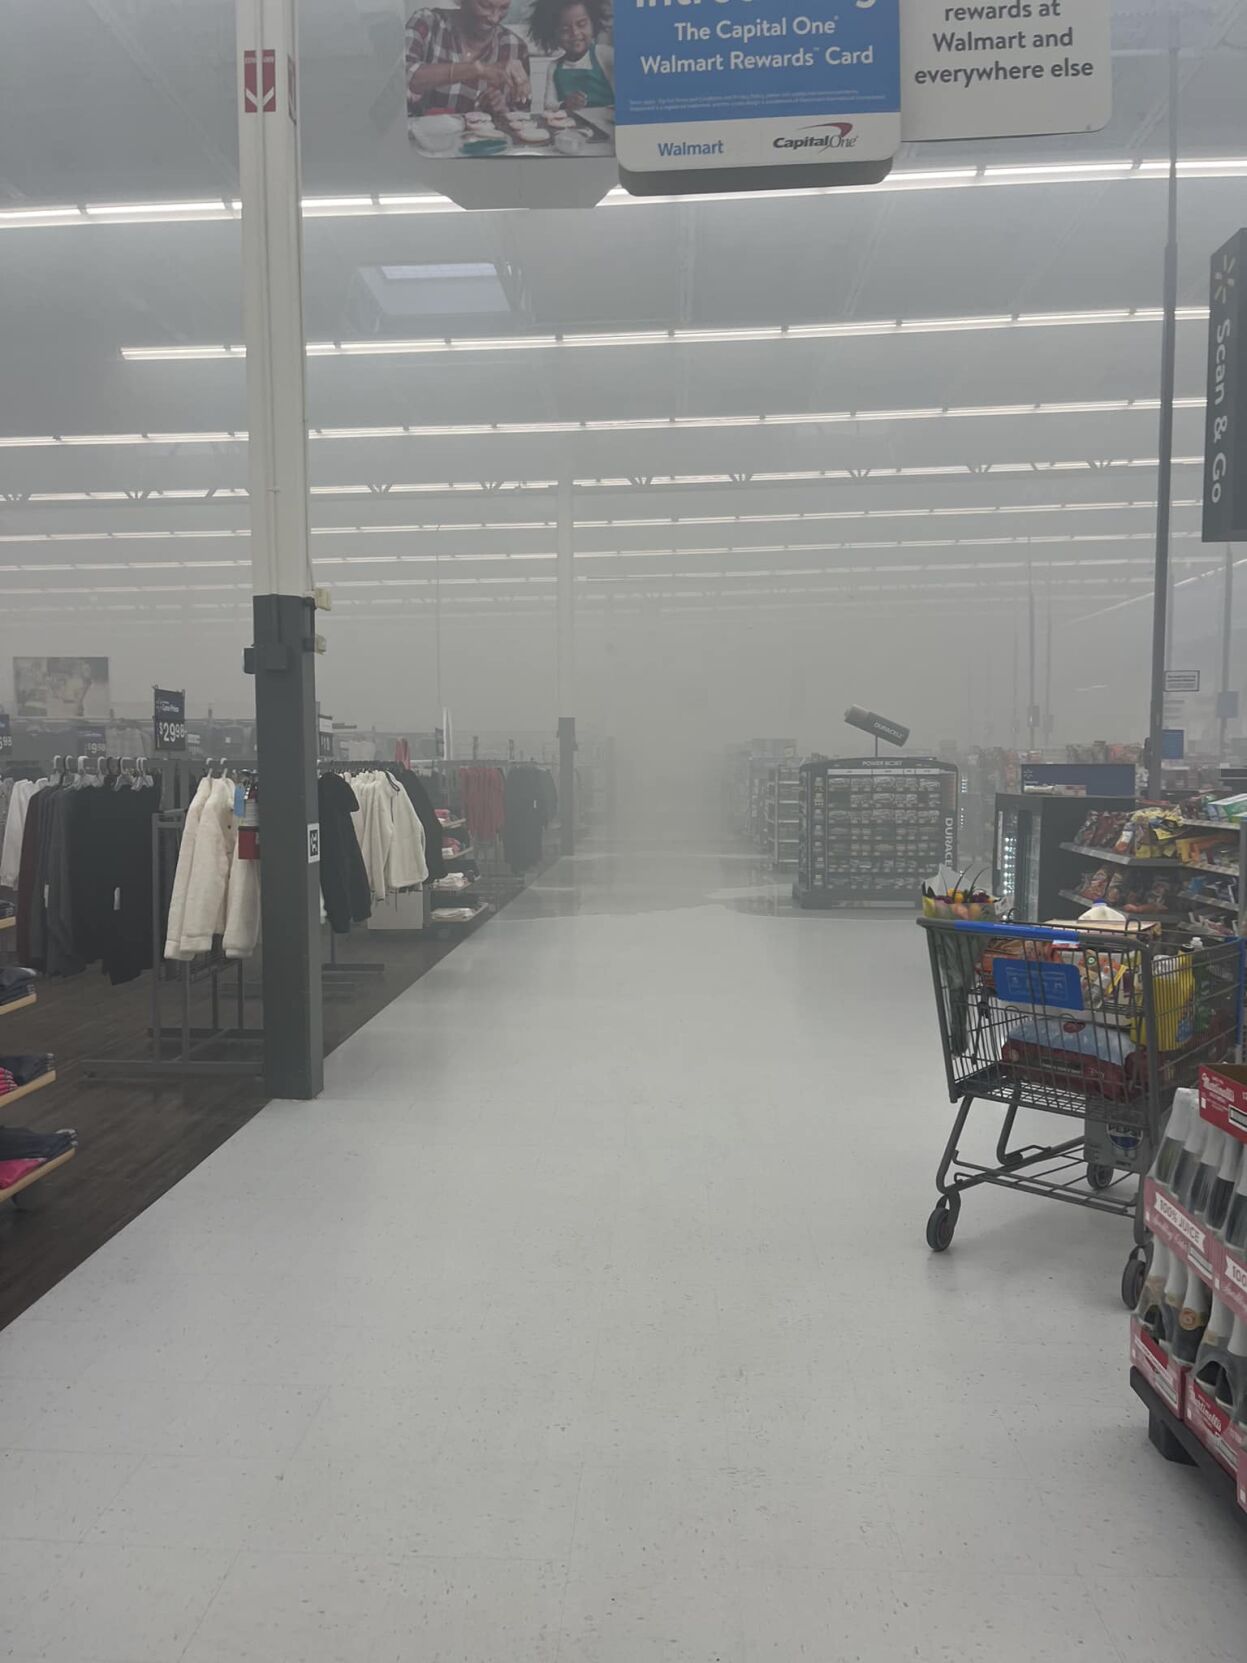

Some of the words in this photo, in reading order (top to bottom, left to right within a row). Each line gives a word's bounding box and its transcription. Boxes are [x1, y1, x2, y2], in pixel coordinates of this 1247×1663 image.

[944, 0, 1032, 21] rewards
[1038, 1, 1061, 17] at
[674, 22, 711, 41] The
[716, 17, 787, 43] Capital
[932, 31, 1026, 52] Walmart
[1032, 26, 1073, 48] and
[640, 53, 724, 75] Walmart
[825, 45, 874, 65] Card
[914, 60, 1044, 88] everywhere
[1051, 57, 1094, 78] else
[657, 140, 724, 157] Walmart
[1214, 319, 1231, 406] Scan
[1213, 416, 1228, 443] &
[1211, 452, 1226, 504] Go
[944, 817, 954, 867] DURACE
[1178, 1216, 1201, 1243] JUICE
